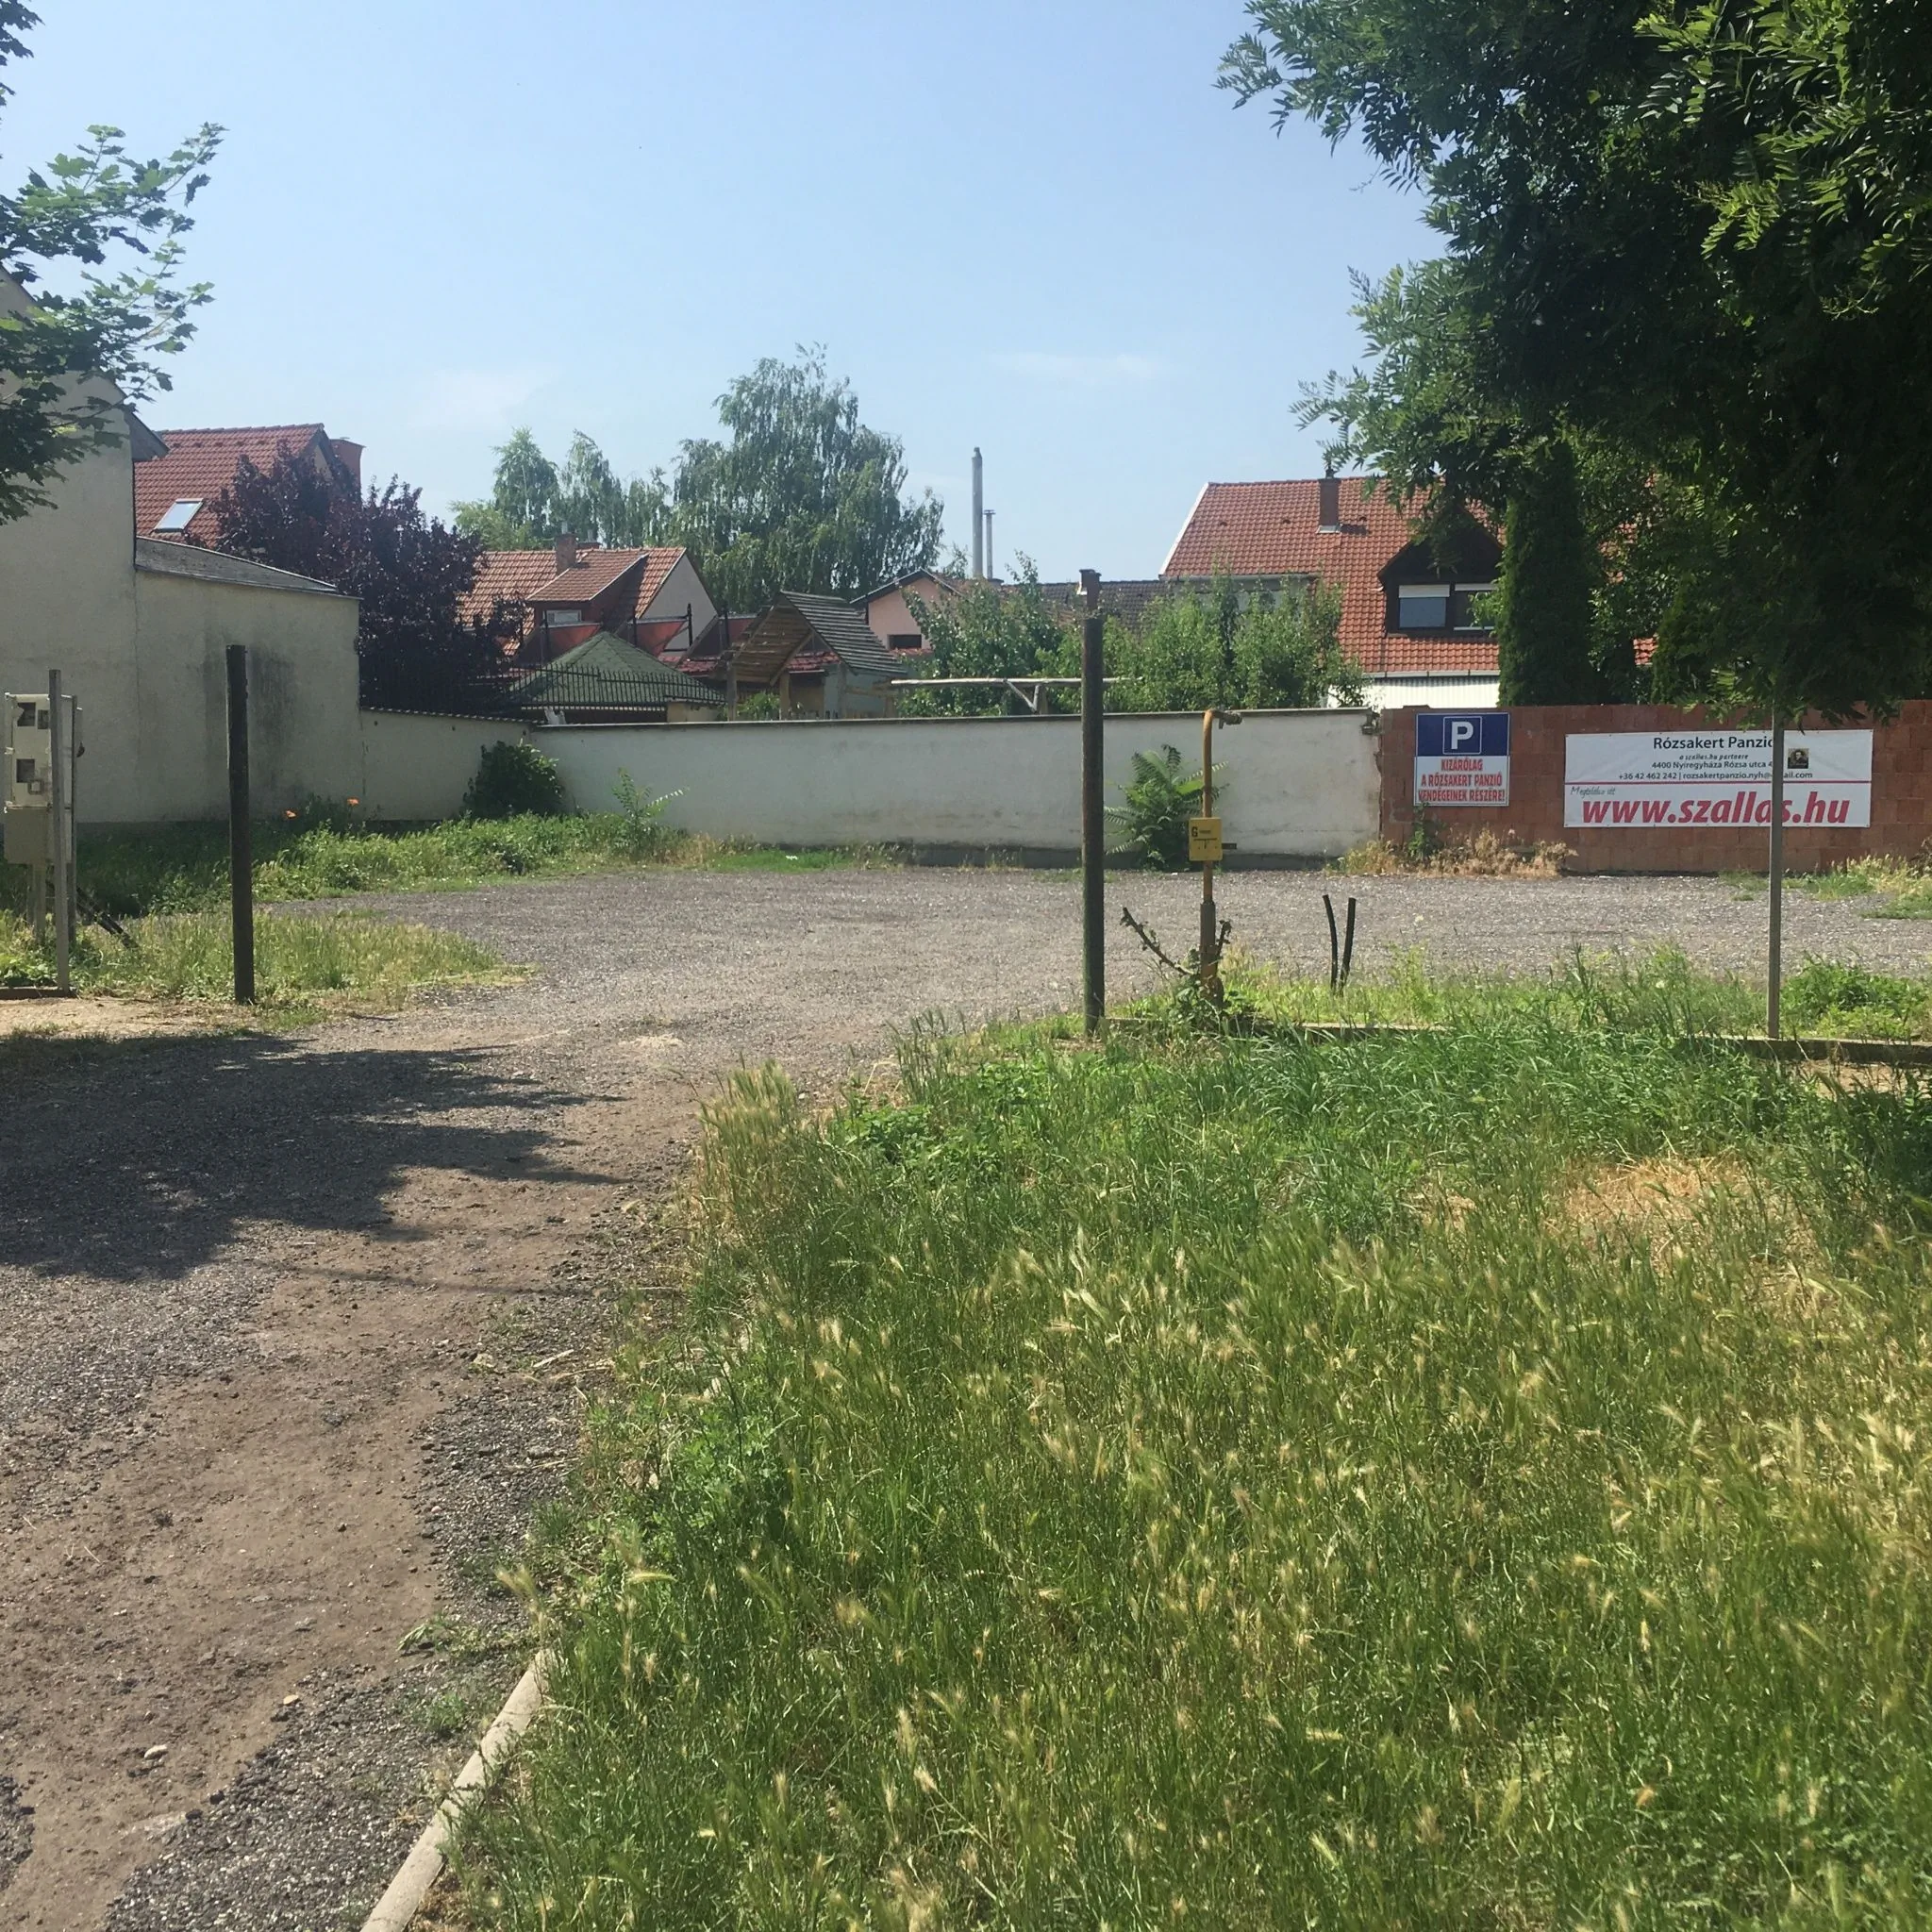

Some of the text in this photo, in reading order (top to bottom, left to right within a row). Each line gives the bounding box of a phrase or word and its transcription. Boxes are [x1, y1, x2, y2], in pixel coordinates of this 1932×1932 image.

[1451, 721, 1474, 750] P
[1654, 737, 1724, 749] Rózsakert
[1441, 758, 1483, 771] KIZÁRÓLAG
[1421, 772, 1502, 786] A RÓZSAKERT PANZIÓ
[1418, 787, 1506, 802] VENDÉGEINEK RÉSZÉRE!
[1583, 791, 1850, 824] www.szallas.hu
